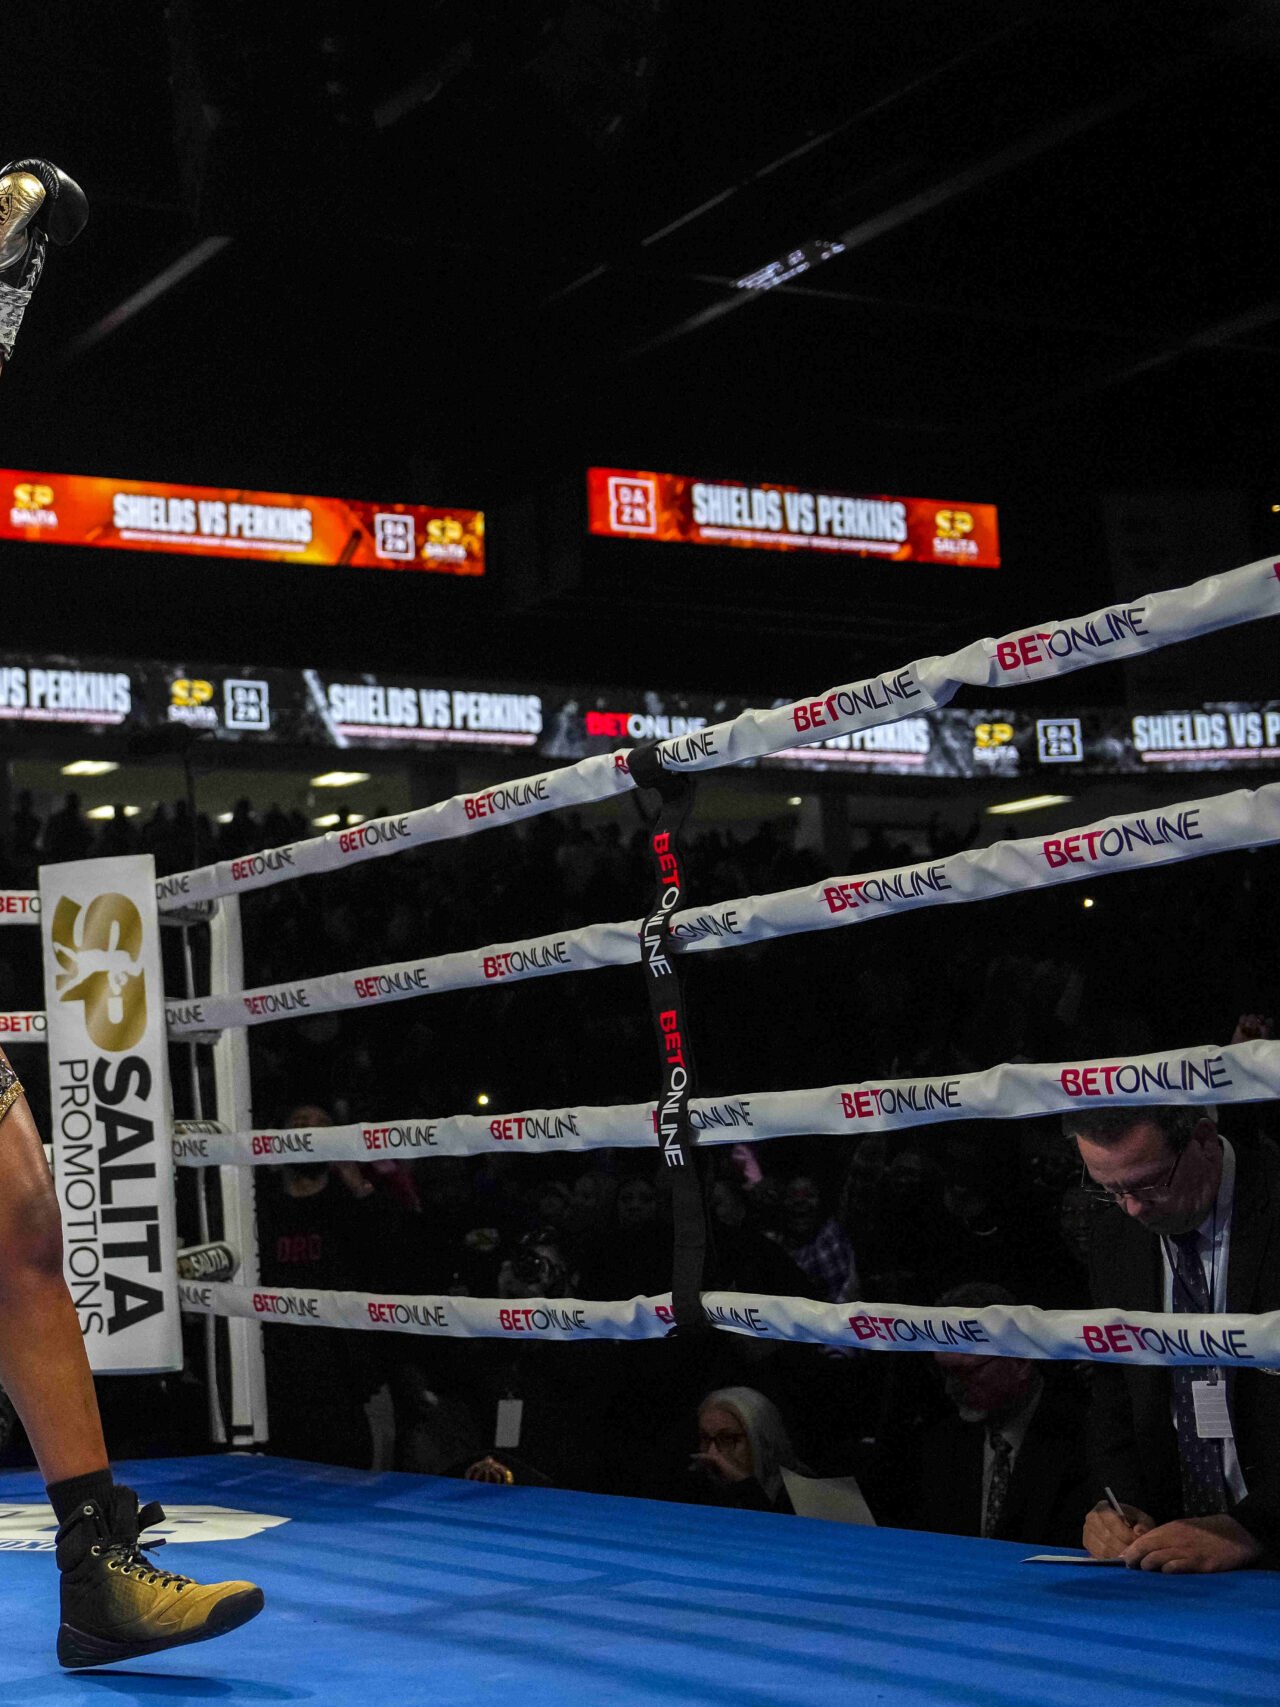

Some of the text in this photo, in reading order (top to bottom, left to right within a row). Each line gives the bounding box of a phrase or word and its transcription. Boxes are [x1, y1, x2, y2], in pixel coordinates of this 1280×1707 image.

[113, 492, 196, 534] SHIELDS
[198, 501, 226, 536] VS
[229, 503, 312, 543] PERKINS
[691, 482, 782, 531] SHIELDS
[783, 492, 815, 534] VS
[818, 495, 906, 543] PERKINS
[996, 607, 1149, 671] BETONLINE
[29, 668, 131, 715] PERKINS
[327, 682, 419, 726] SHIELDS
[420, 689, 451, 729] VS
[453, 690, 542, 735] PERKINS
[585, 710, 707, 739] BETONLINE
[1133, 713, 1228, 751] SHIELDS
[1229, 712, 1263, 747] VS
[464, 777, 550, 821] BETONLINE
[1038, 808, 1203, 869] BETONLINE
[645, 830, 680, 977] BETONLINE
[822, 864, 952, 913] BETONLINE
[481, 940, 571, 980] BETONLINE
[659, 1009, 687, 1168] BETONLINE
[1053, 1057, 1233, 1096] BETONLINE
[838, 1080, 961, 1119] BETONLINE
[488, 1114, 579, 1141] BETONLINE
[59, 1059, 104, 1336] PROMOTIONS
[92, 1055, 164, 1336] SALITA
[367, 1303, 448, 1326] BETONLINE
[499, 1307, 591, 1332] BETONLINE
[847, 1314, 989, 1344] BETONLINE
[1077, 1324, 1256, 1360] BETONLINE
